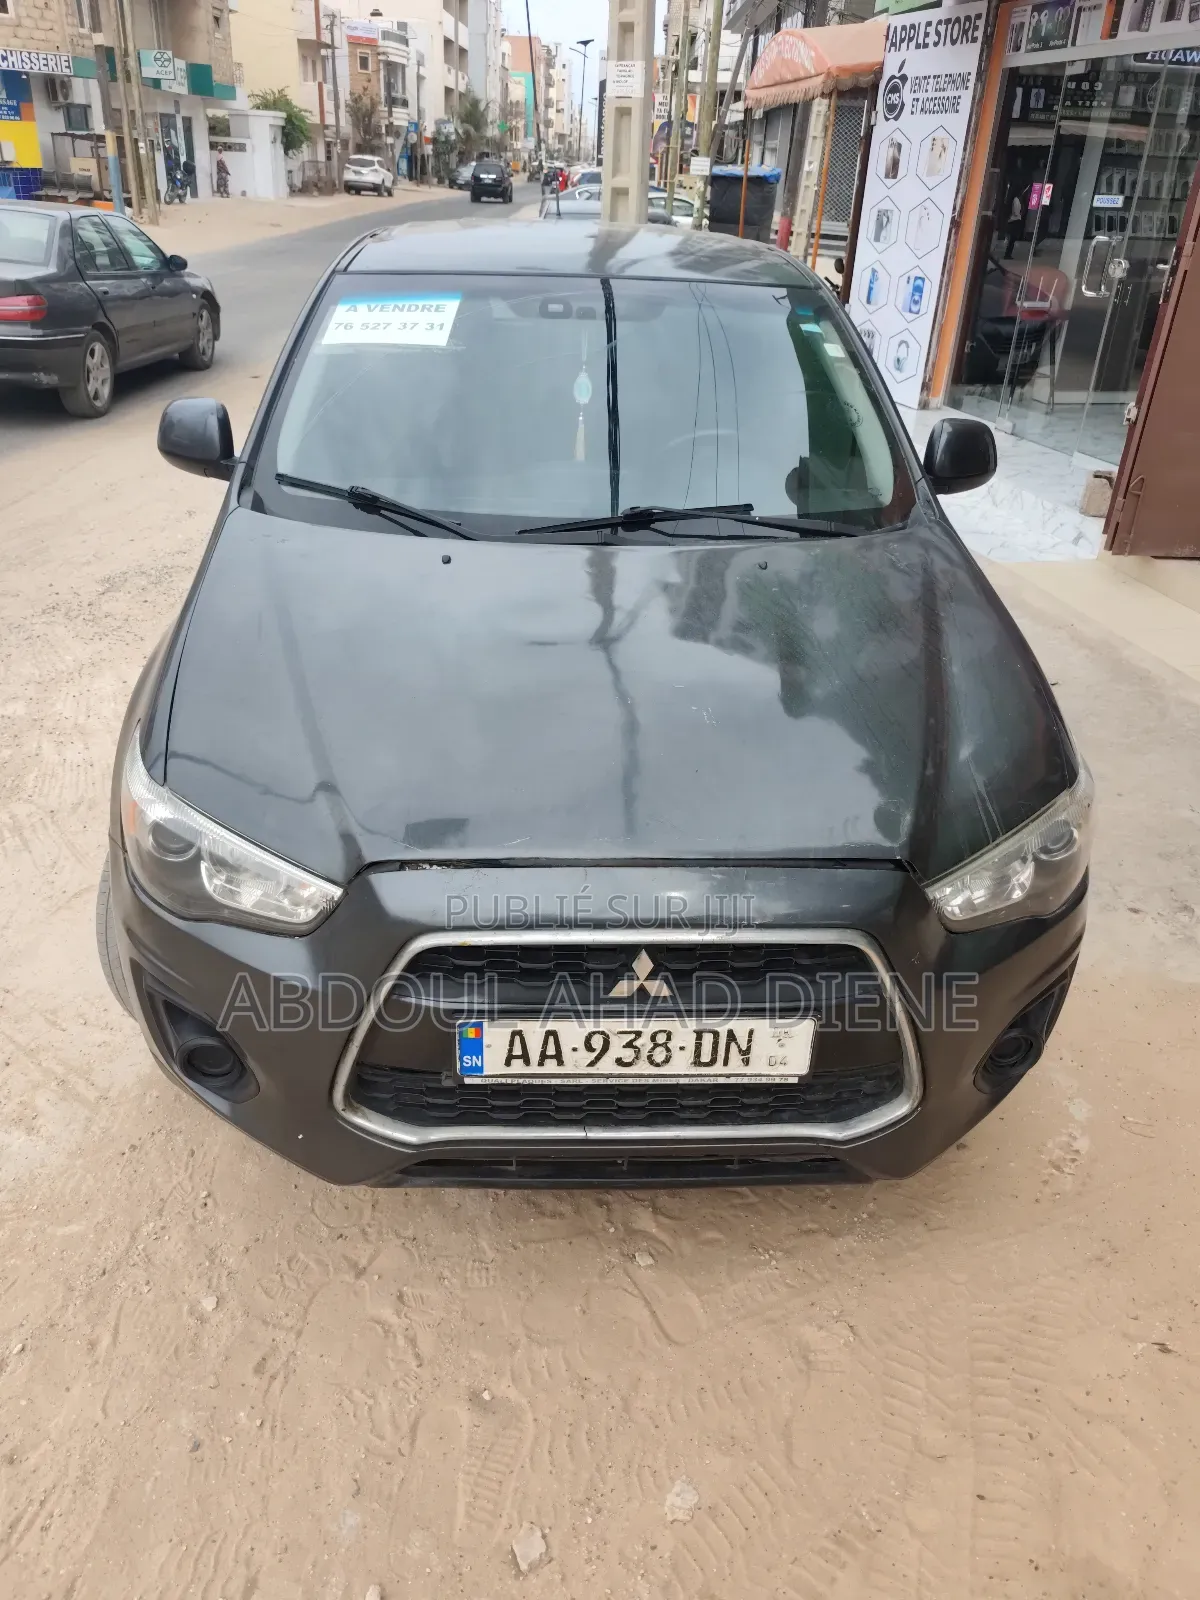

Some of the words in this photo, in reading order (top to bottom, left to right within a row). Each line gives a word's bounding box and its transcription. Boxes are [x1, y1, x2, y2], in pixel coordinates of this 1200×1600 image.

[888, 20, 932, 53] APPLE
[933, 12, 982, 48] STORE
[0, 49, 70, 74] CHISSERIE
[910, 75, 931, 94] VENTE
[931, 72, 972, 92] TELEPHONE
[911, 97, 920, 115] ET
[920, 95, 961, 115] ACCESSOIRE
[1096, 197, 1120, 205] POUSSEZ
[345, 304, 358, 313] A
[366, 303, 447, 313] VENDRE
[334, 322, 354, 331] 76
[360, 322, 392, 331] 527
[397, 322, 419, 331] 37
[424, 322, 445, 331] 31
[462, 1055, 482, 1067] SN
